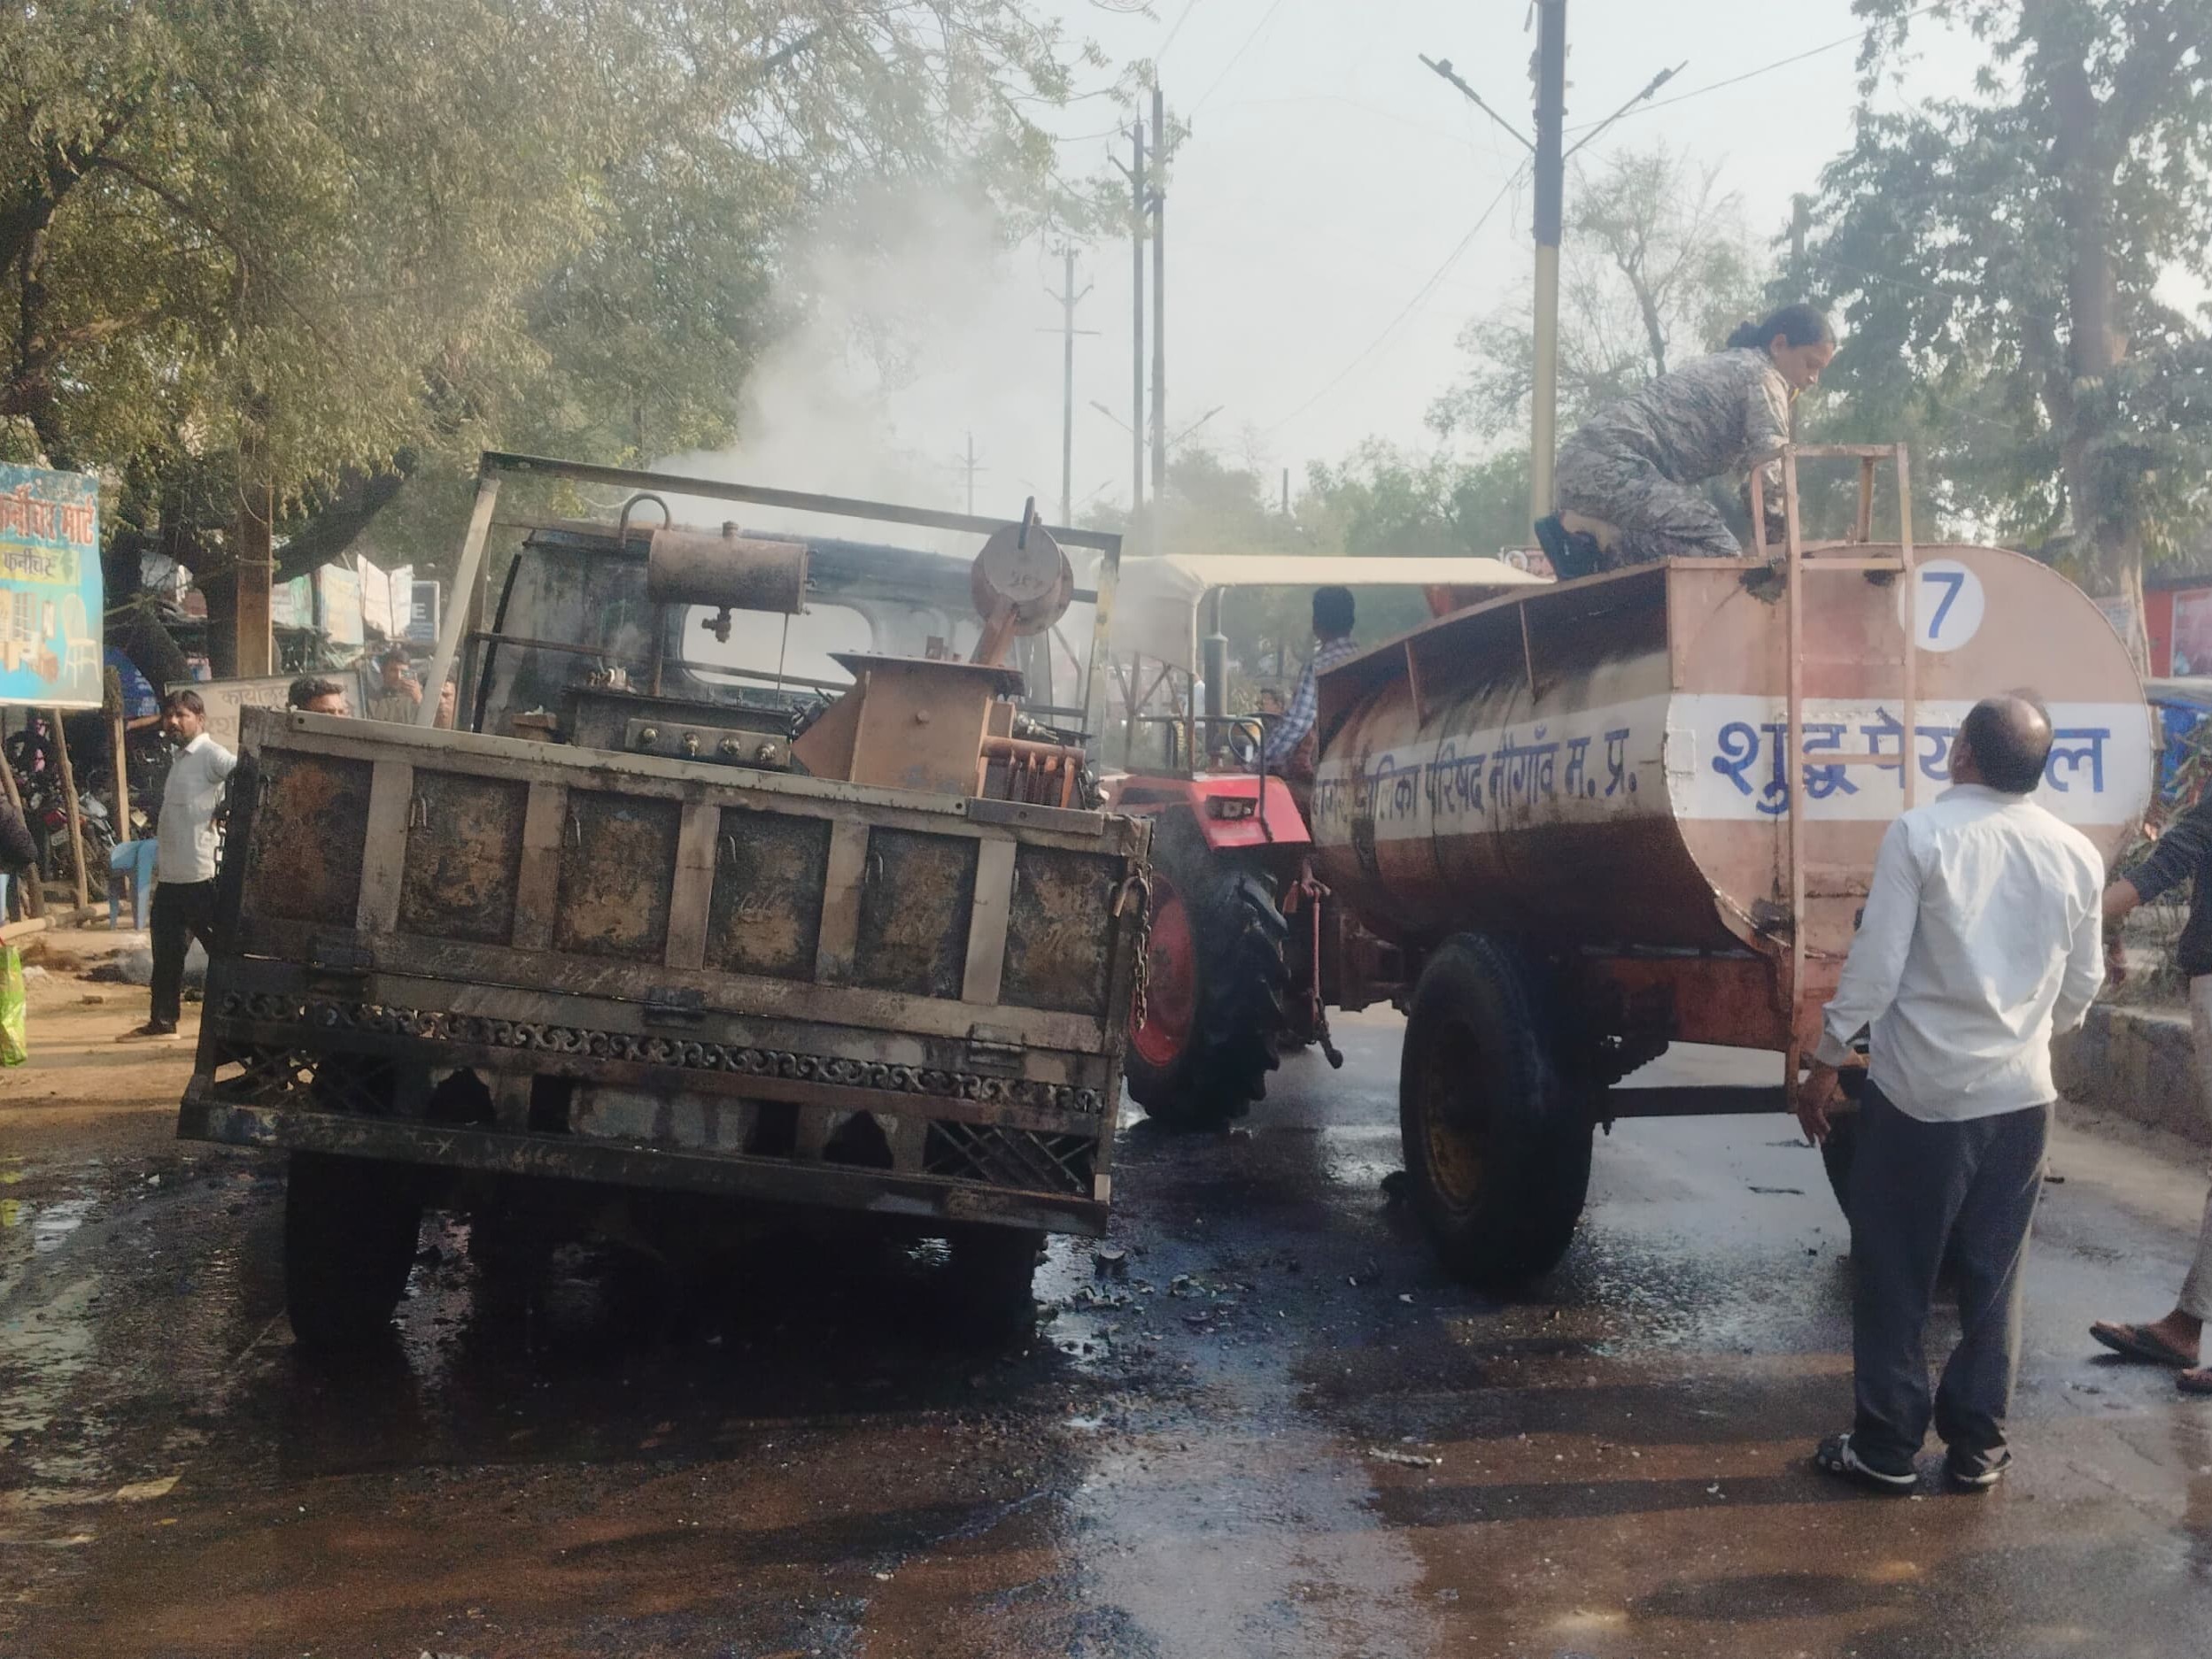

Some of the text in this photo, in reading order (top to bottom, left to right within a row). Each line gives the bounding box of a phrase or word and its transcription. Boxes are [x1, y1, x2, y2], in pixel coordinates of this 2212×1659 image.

[1922, 571, 1965, 639] 7
[1425, 742, 1486, 815] परिषद
[1860, 706, 2111, 793] पेयल
